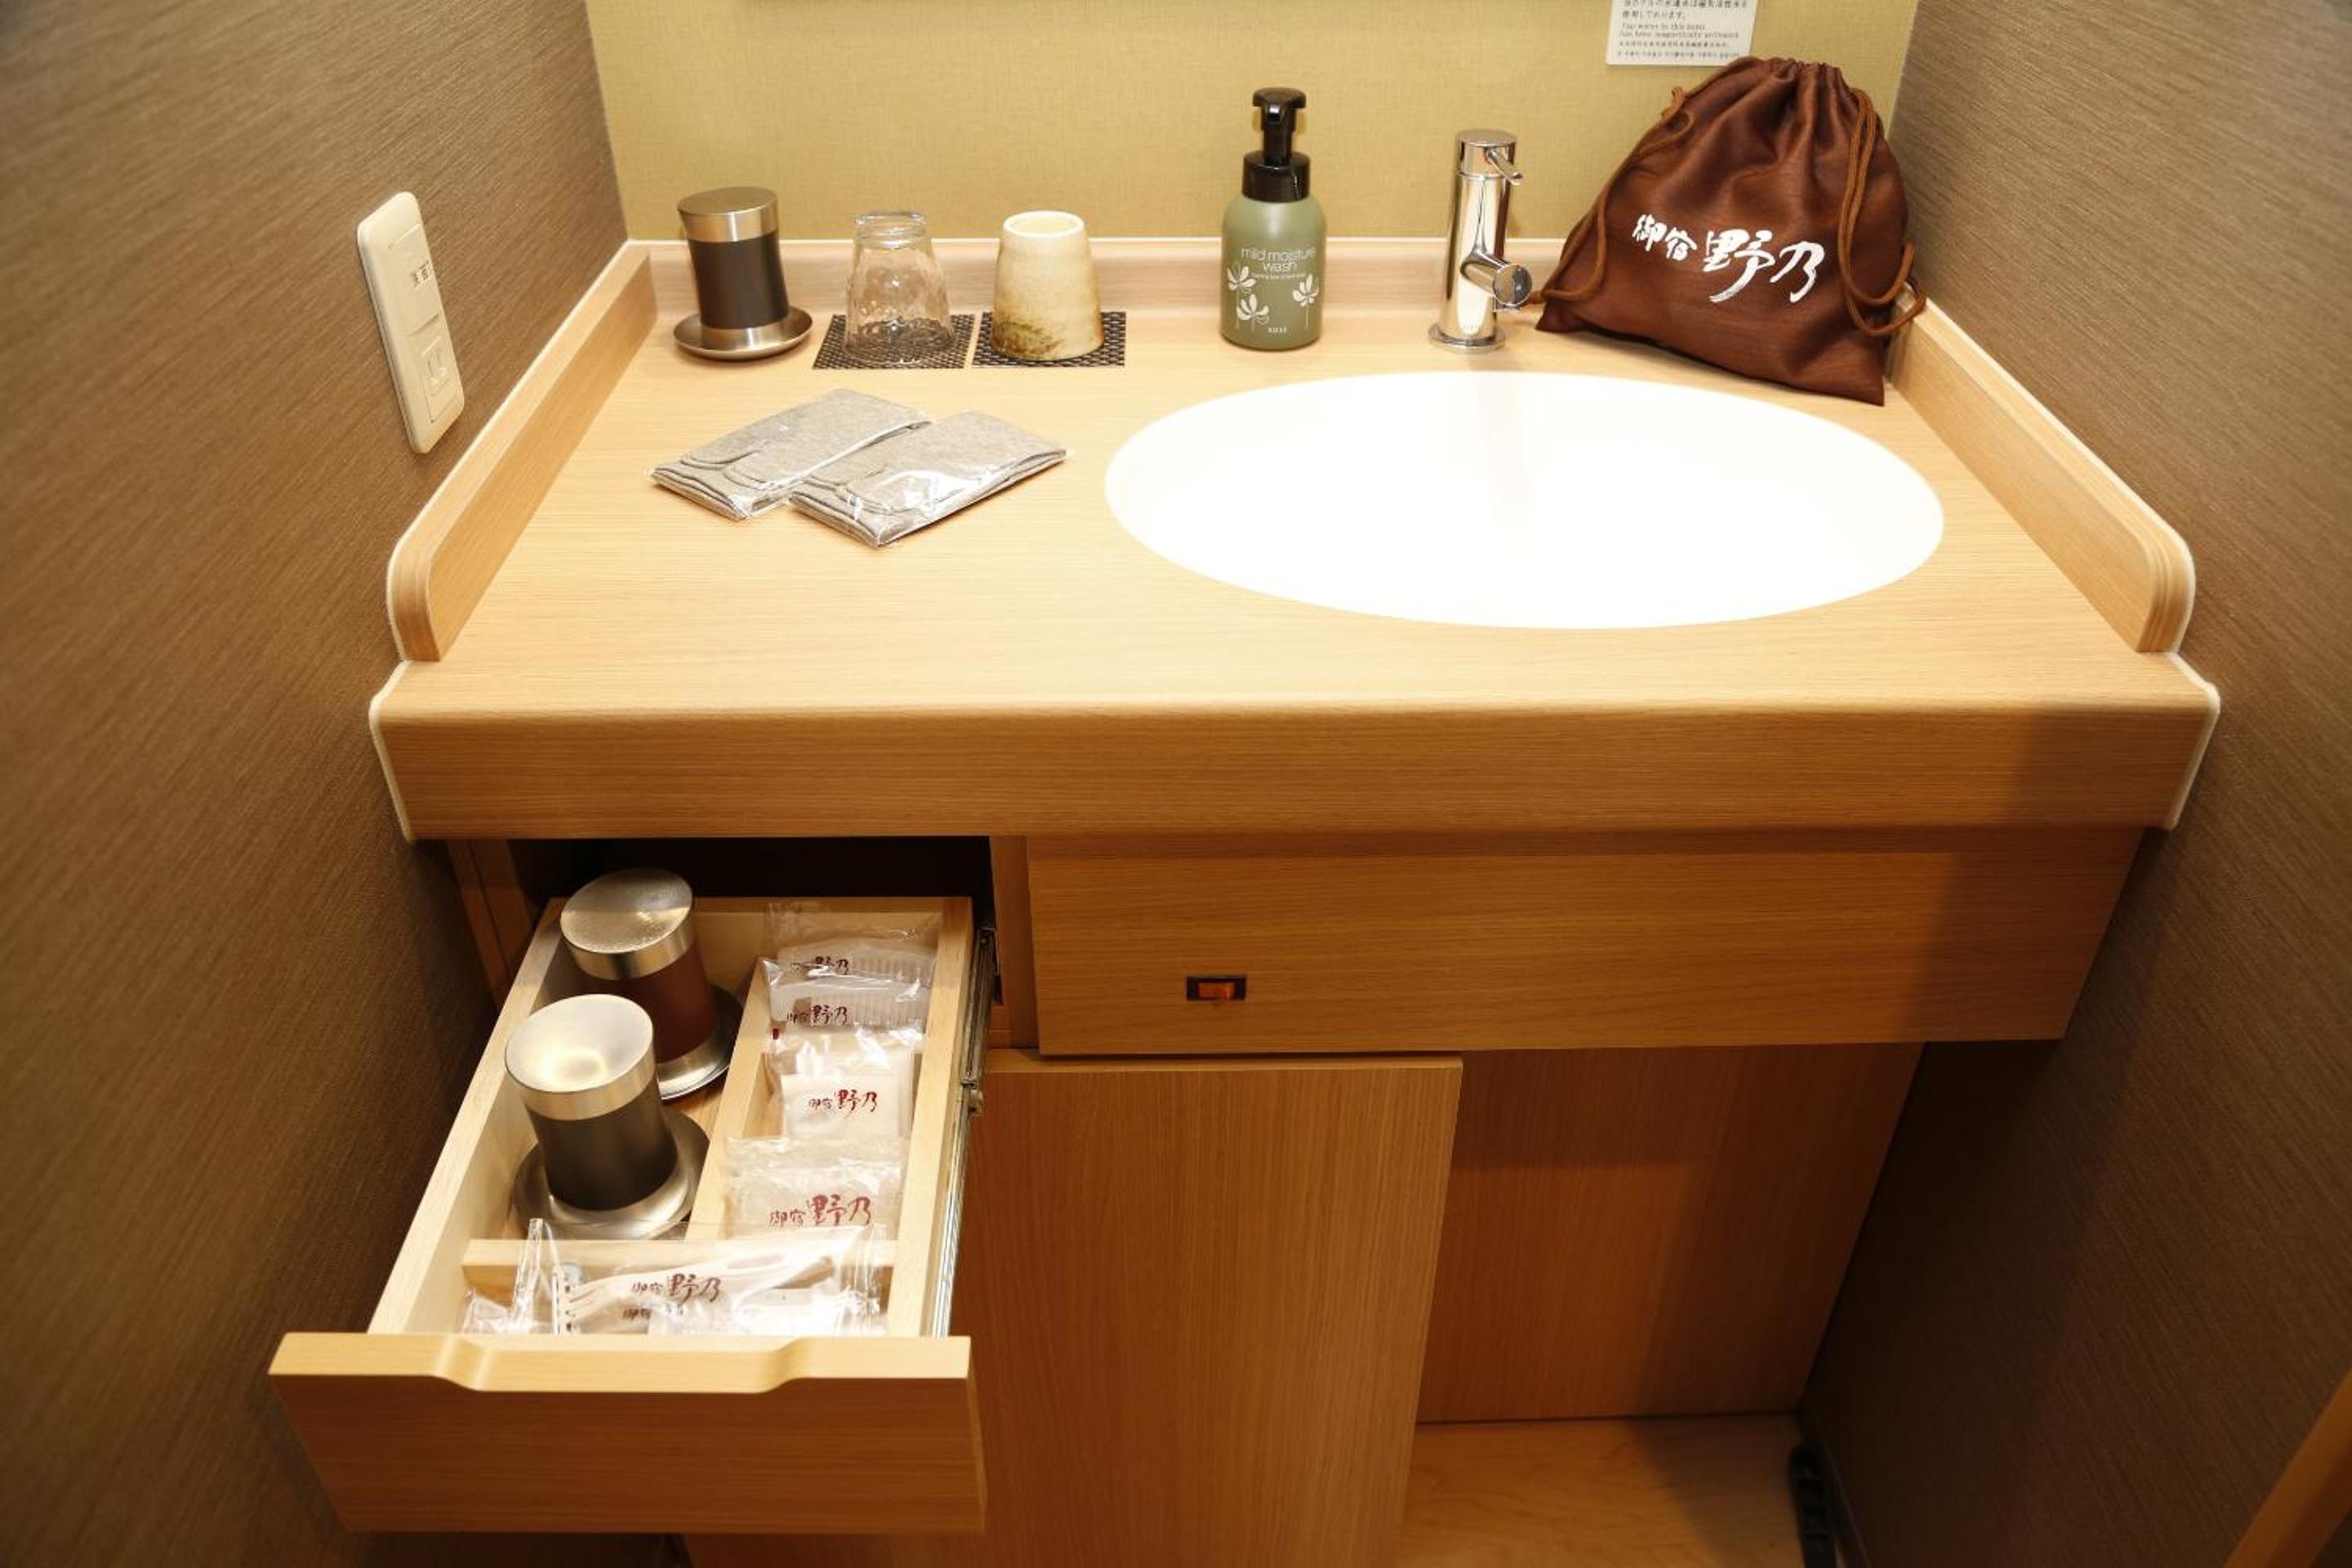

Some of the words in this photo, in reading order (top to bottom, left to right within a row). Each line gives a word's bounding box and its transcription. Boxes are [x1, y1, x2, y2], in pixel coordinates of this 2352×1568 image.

[1241, 247, 1266, 261] mild
[1267, 247, 1316, 262] moisture
[1263, 260, 1297, 272] wash
